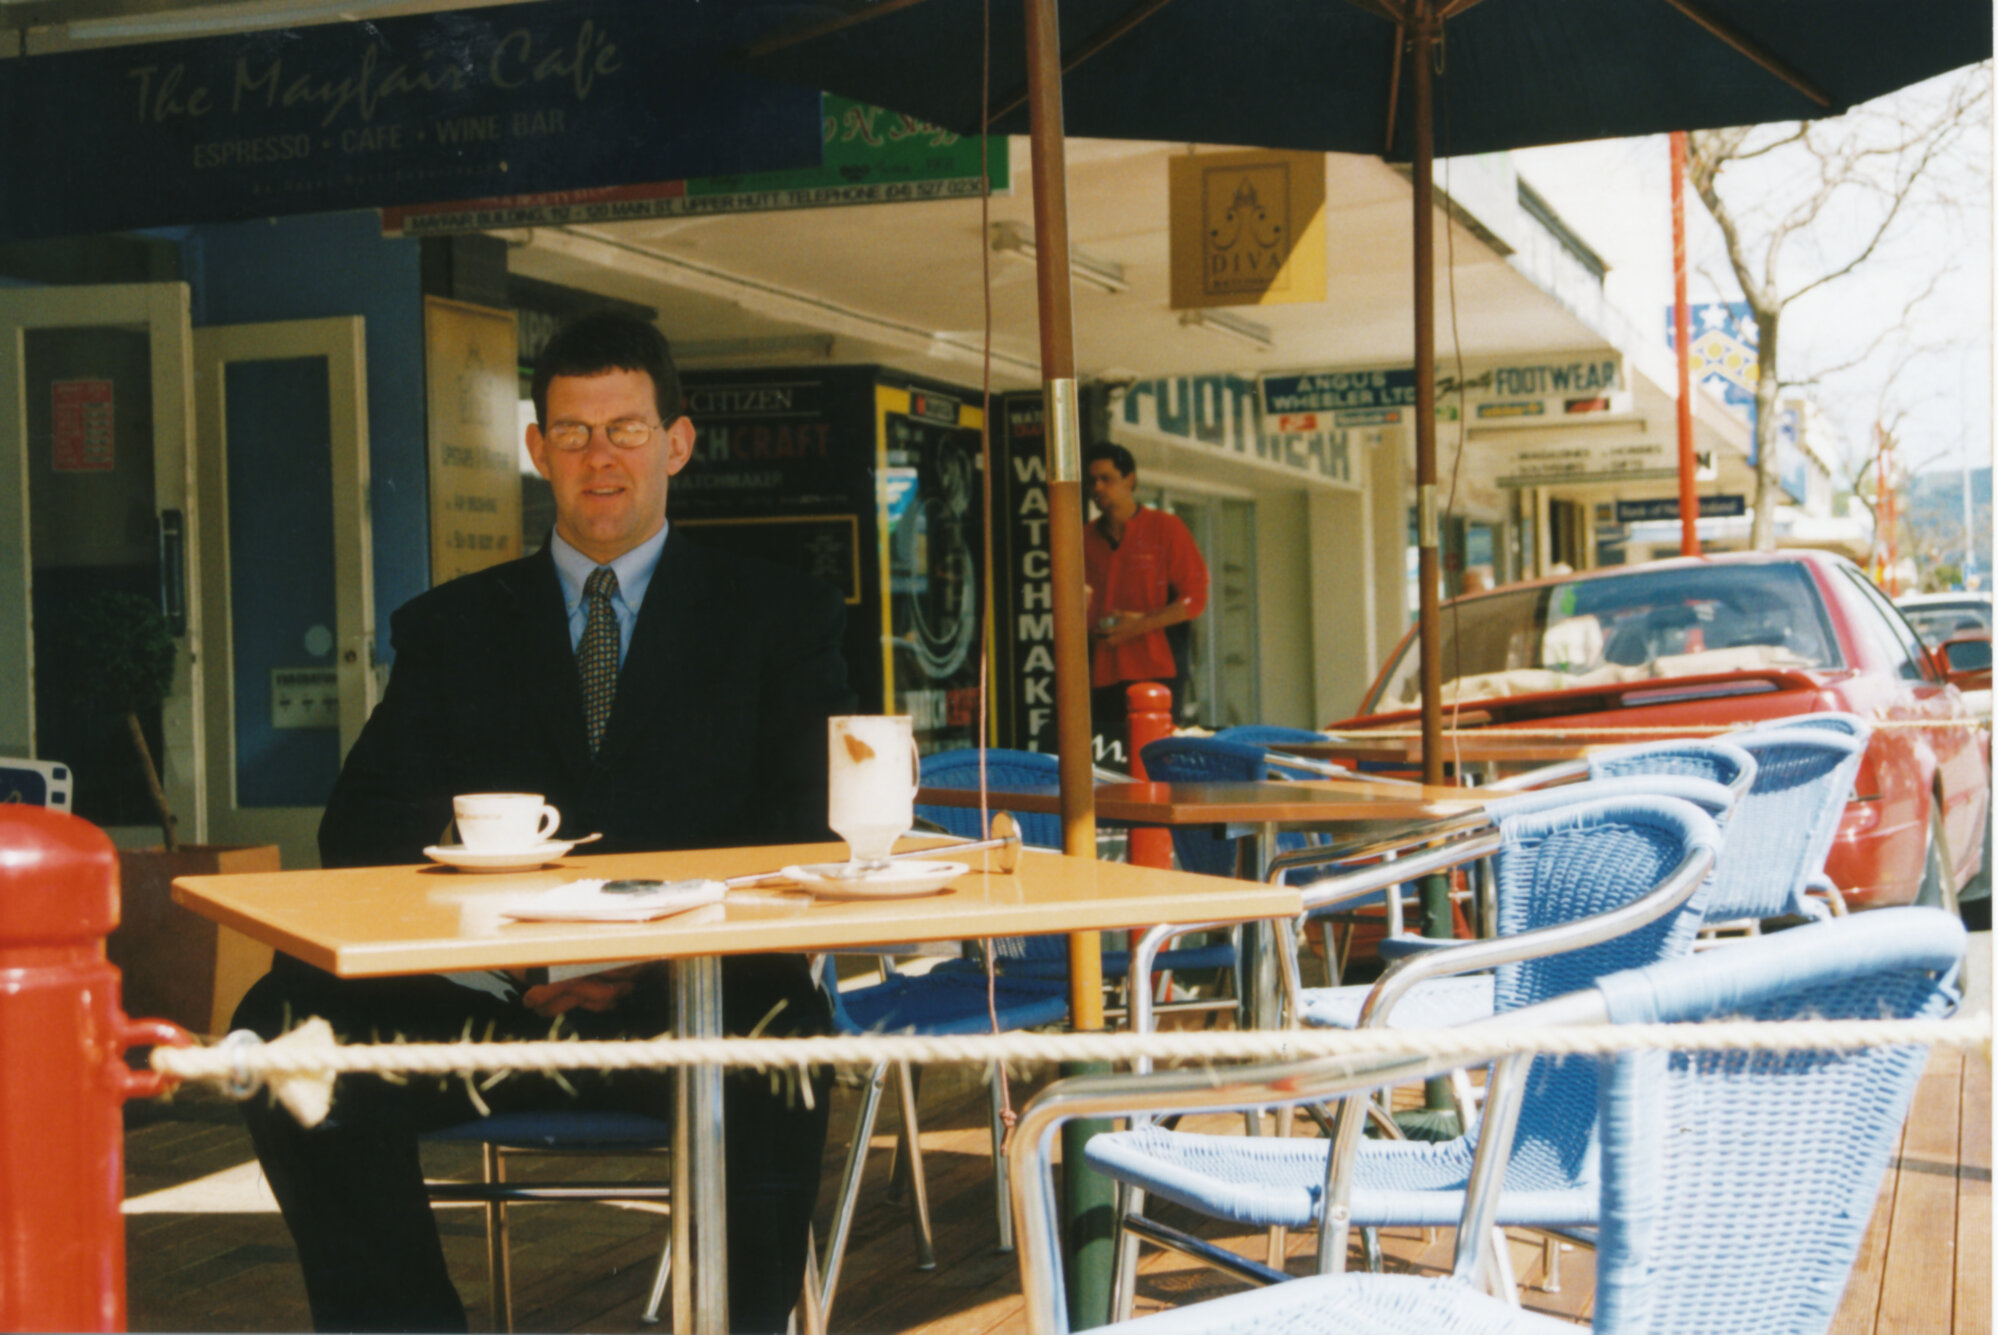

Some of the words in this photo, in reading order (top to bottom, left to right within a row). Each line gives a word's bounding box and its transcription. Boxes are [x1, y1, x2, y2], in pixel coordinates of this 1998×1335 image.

[127, 61, 214, 126] The
[230, 41, 469, 129] Mayfair
[193, 133, 311, 169] ESPRESSO
[340, 125, 403, 154] CAFE
[435, 115, 501, 145] WINE
[513, 108, 566, 136] BAR
[611, 201, 650, 217] MAIN
[682, 194, 734, 211] UPPER
[738, 190, 779, 207] HUTT
[788, 184, 879, 204] TELEPHONE
[1211, 252, 1281, 274] DIVA
[1296, 371, 1387, 392] ANGUS
[1495, 360, 1615, 396] FOOTWEAR
[689, 388, 794, 413] CITIZEN
[1271, 388, 1375, 410] WHEELER
